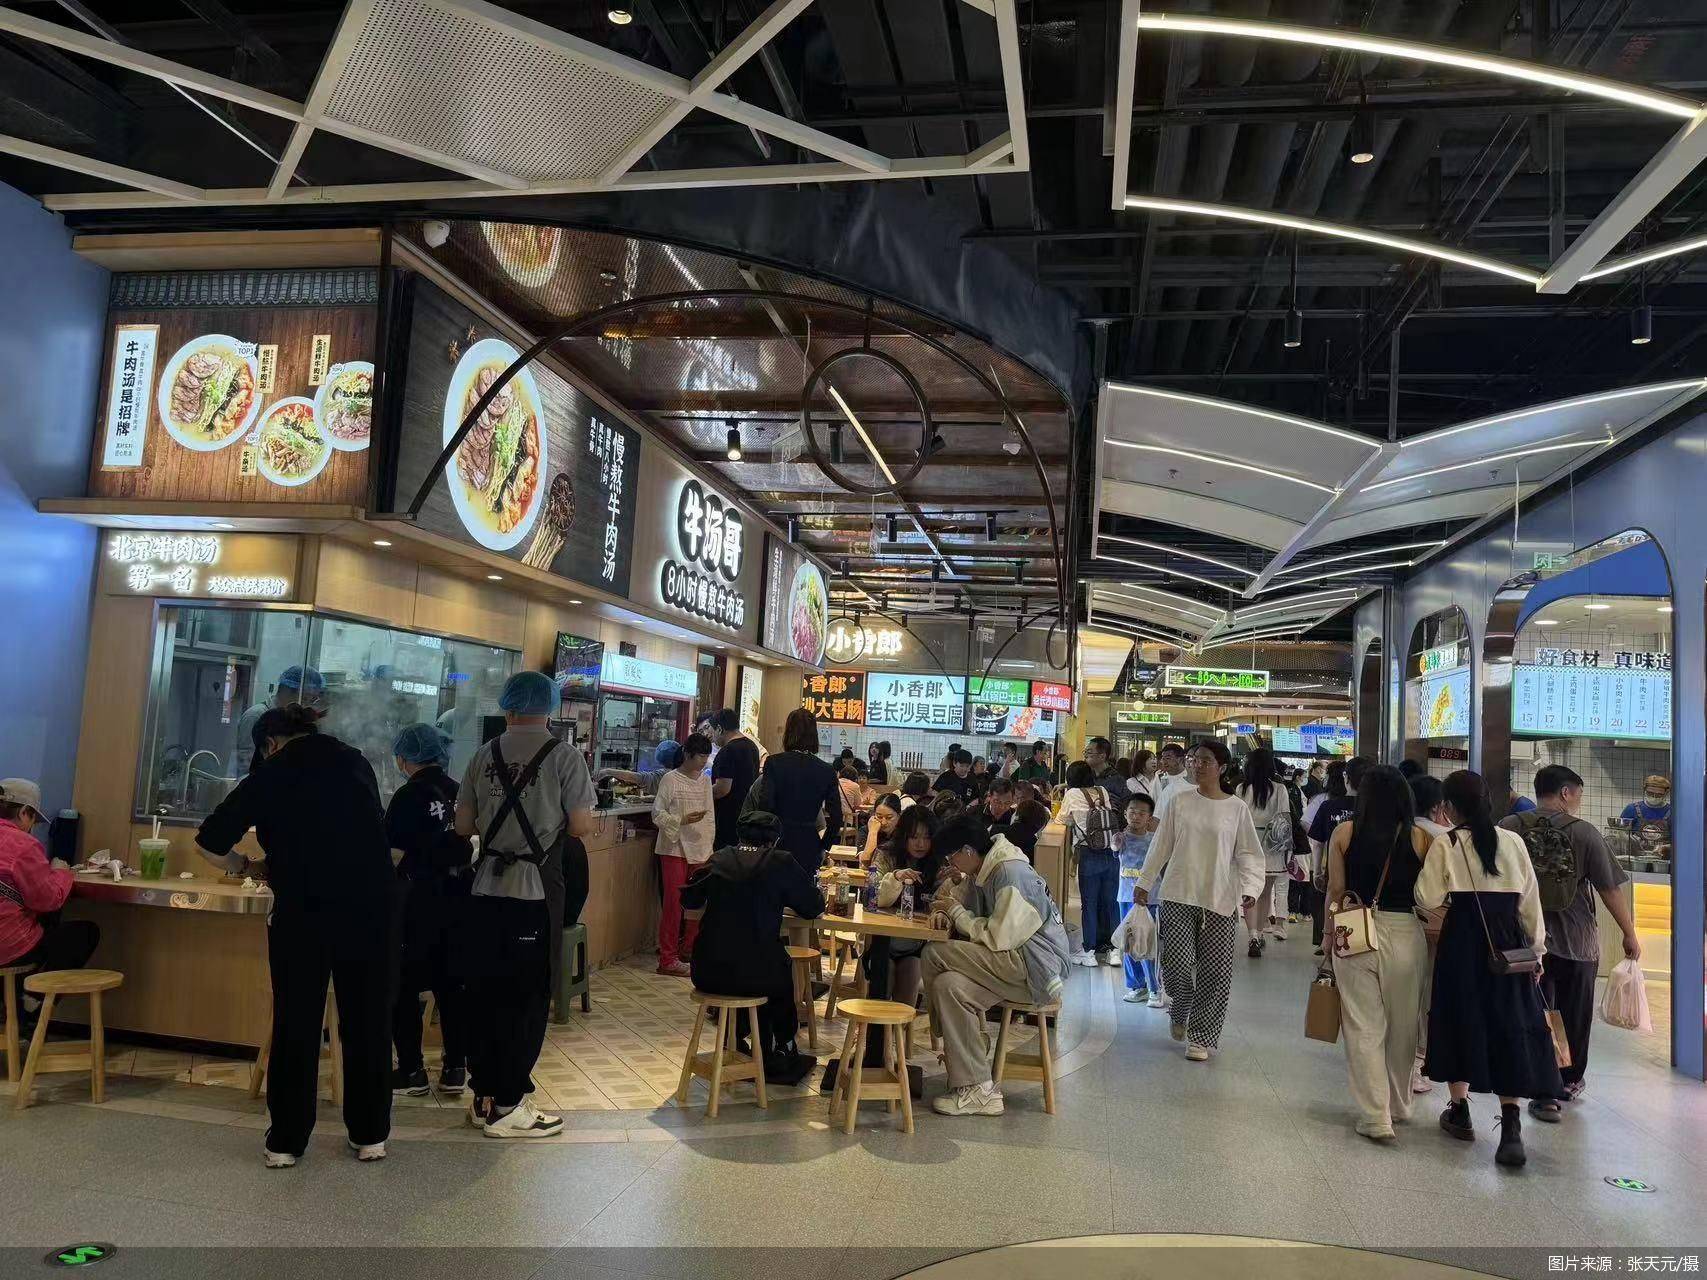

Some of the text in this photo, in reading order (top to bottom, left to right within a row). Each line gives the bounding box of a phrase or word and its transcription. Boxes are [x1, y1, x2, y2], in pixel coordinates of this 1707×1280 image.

[116, 341, 139, 437] 牛肉汤是招牌
[602, 431, 625, 582] 慢熬牛肉汤
[684, 488, 743, 577] 牛汤哥
[110, 535, 219, 563] 北京牛肉汤
[128, 565, 194, 592] 第一名
[827, 626, 903, 655] 小香郎
[1536, 648, 1672, 671] 好食材 真味道
[804, 675, 847, 693] 香郎
[887, 680, 944, 699] 小香郎
[985, 680, 1012, 690] 小香郎
[868, 702, 964, 727] 老长沙臭豆腐
[1545, 714, 1555, 723] 17
[1635, 720, 1648, 728] 22
